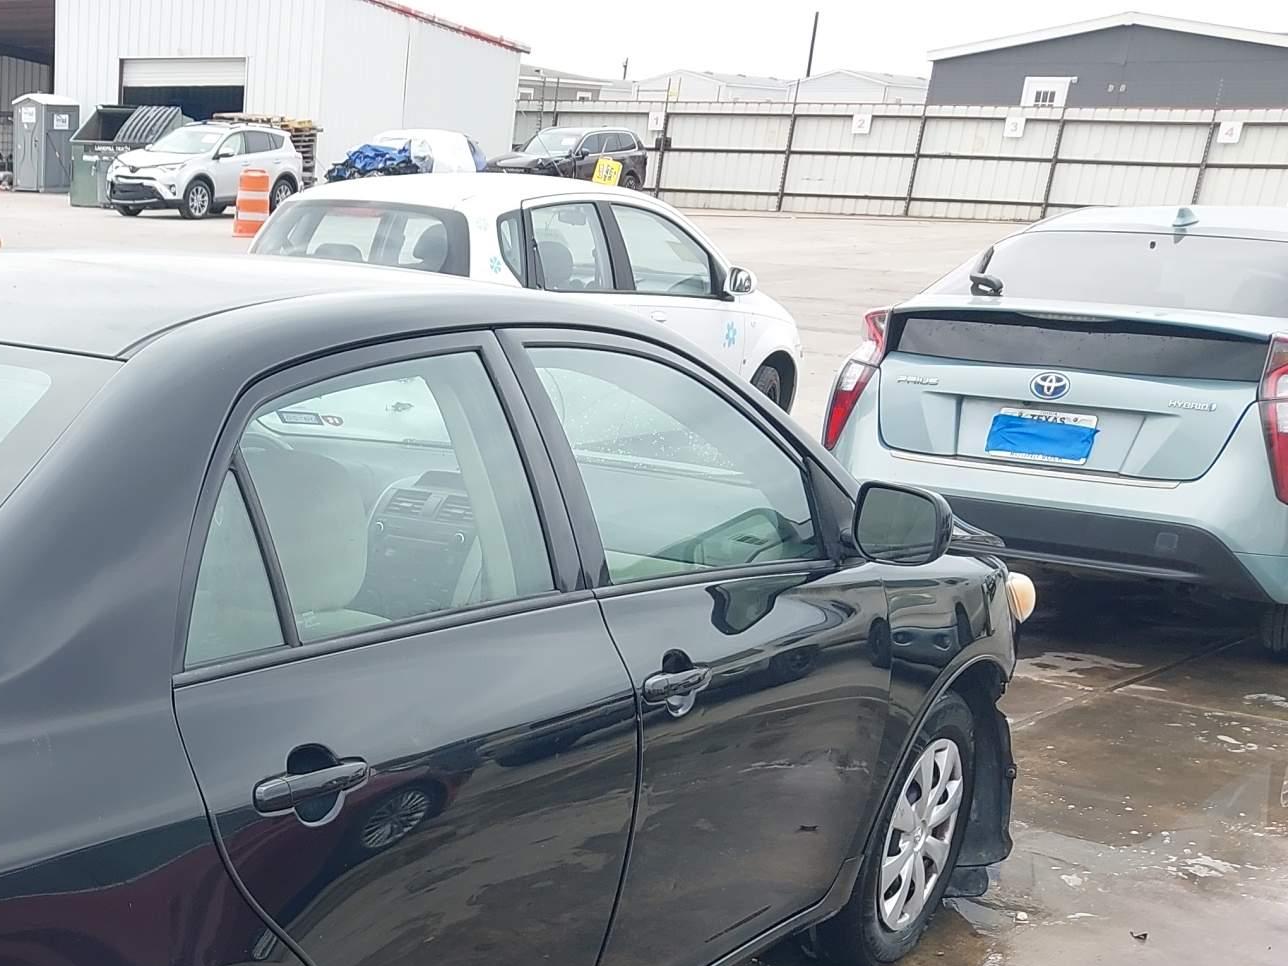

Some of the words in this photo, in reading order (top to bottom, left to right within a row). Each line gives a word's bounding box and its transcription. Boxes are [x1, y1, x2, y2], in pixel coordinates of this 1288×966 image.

[857, 119, 866, 129] 2
[1011, 121, 1018, 132] 3
[1224, 127, 1234, 138] 4
[1167, 399, 1210, 412] HYBRID
